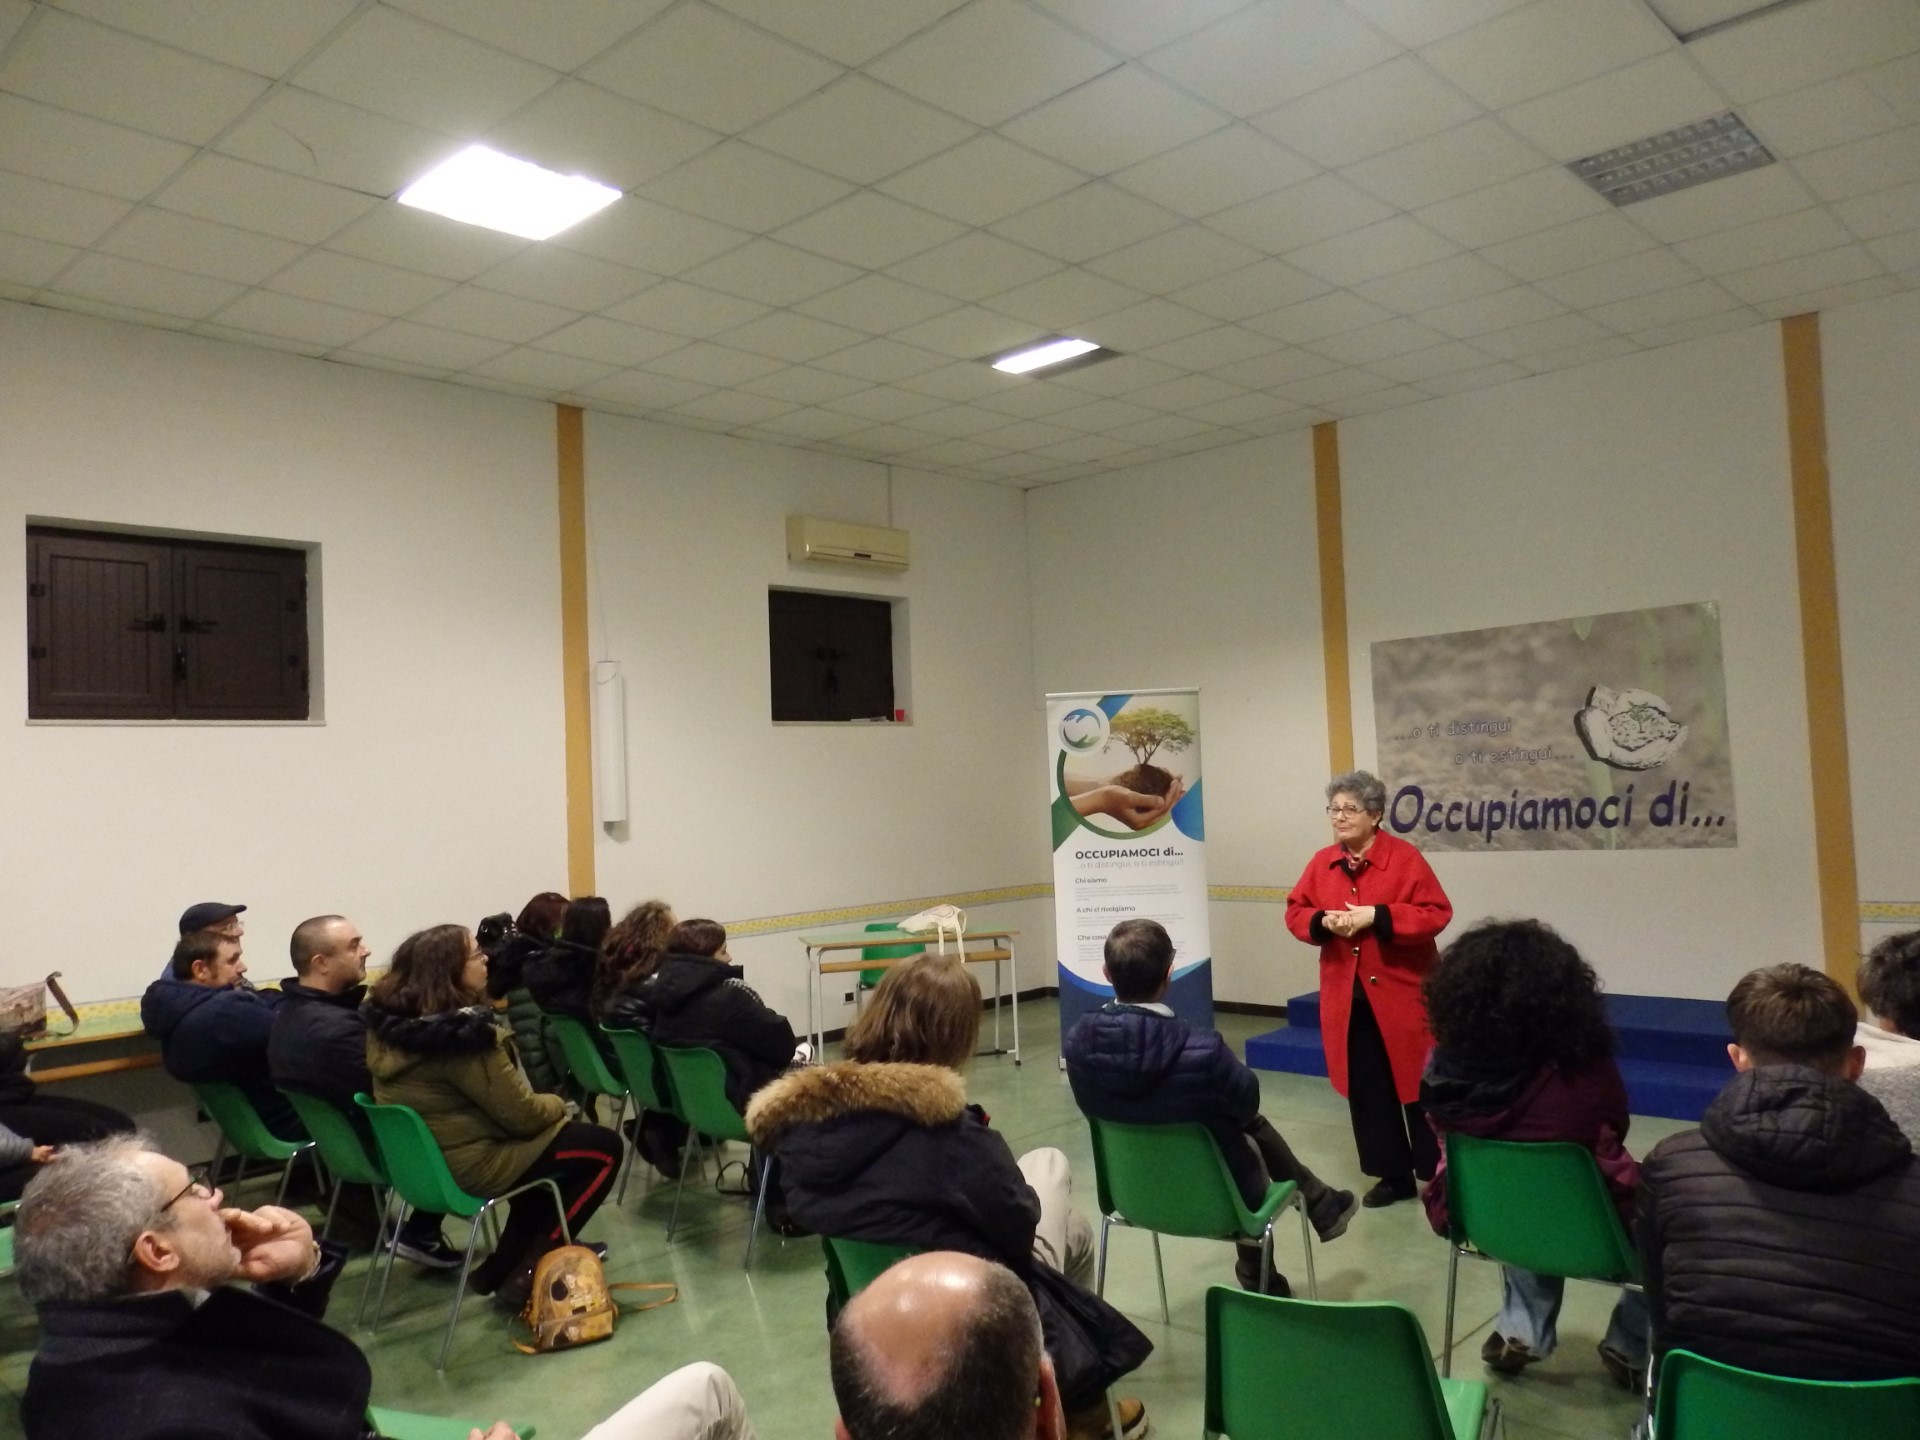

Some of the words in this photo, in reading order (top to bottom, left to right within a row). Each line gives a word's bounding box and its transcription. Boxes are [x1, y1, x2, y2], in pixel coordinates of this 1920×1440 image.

[1428, 723, 1440, 737] ti
[1447, 717, 1512, 737] distingui
[1455, 753, 1463, 765] o
[1471, 751, 1483, 764] ti
[1390, 783, 1634, 844] Occupiamoci
[1649, 779, 1726, 828] di...
[1075, 848, 1160, 860] OCCUPIAMOCI
[1163, 846, 1184, 857] di...
[1101, 905, 1136, 914] rivolgiamo
